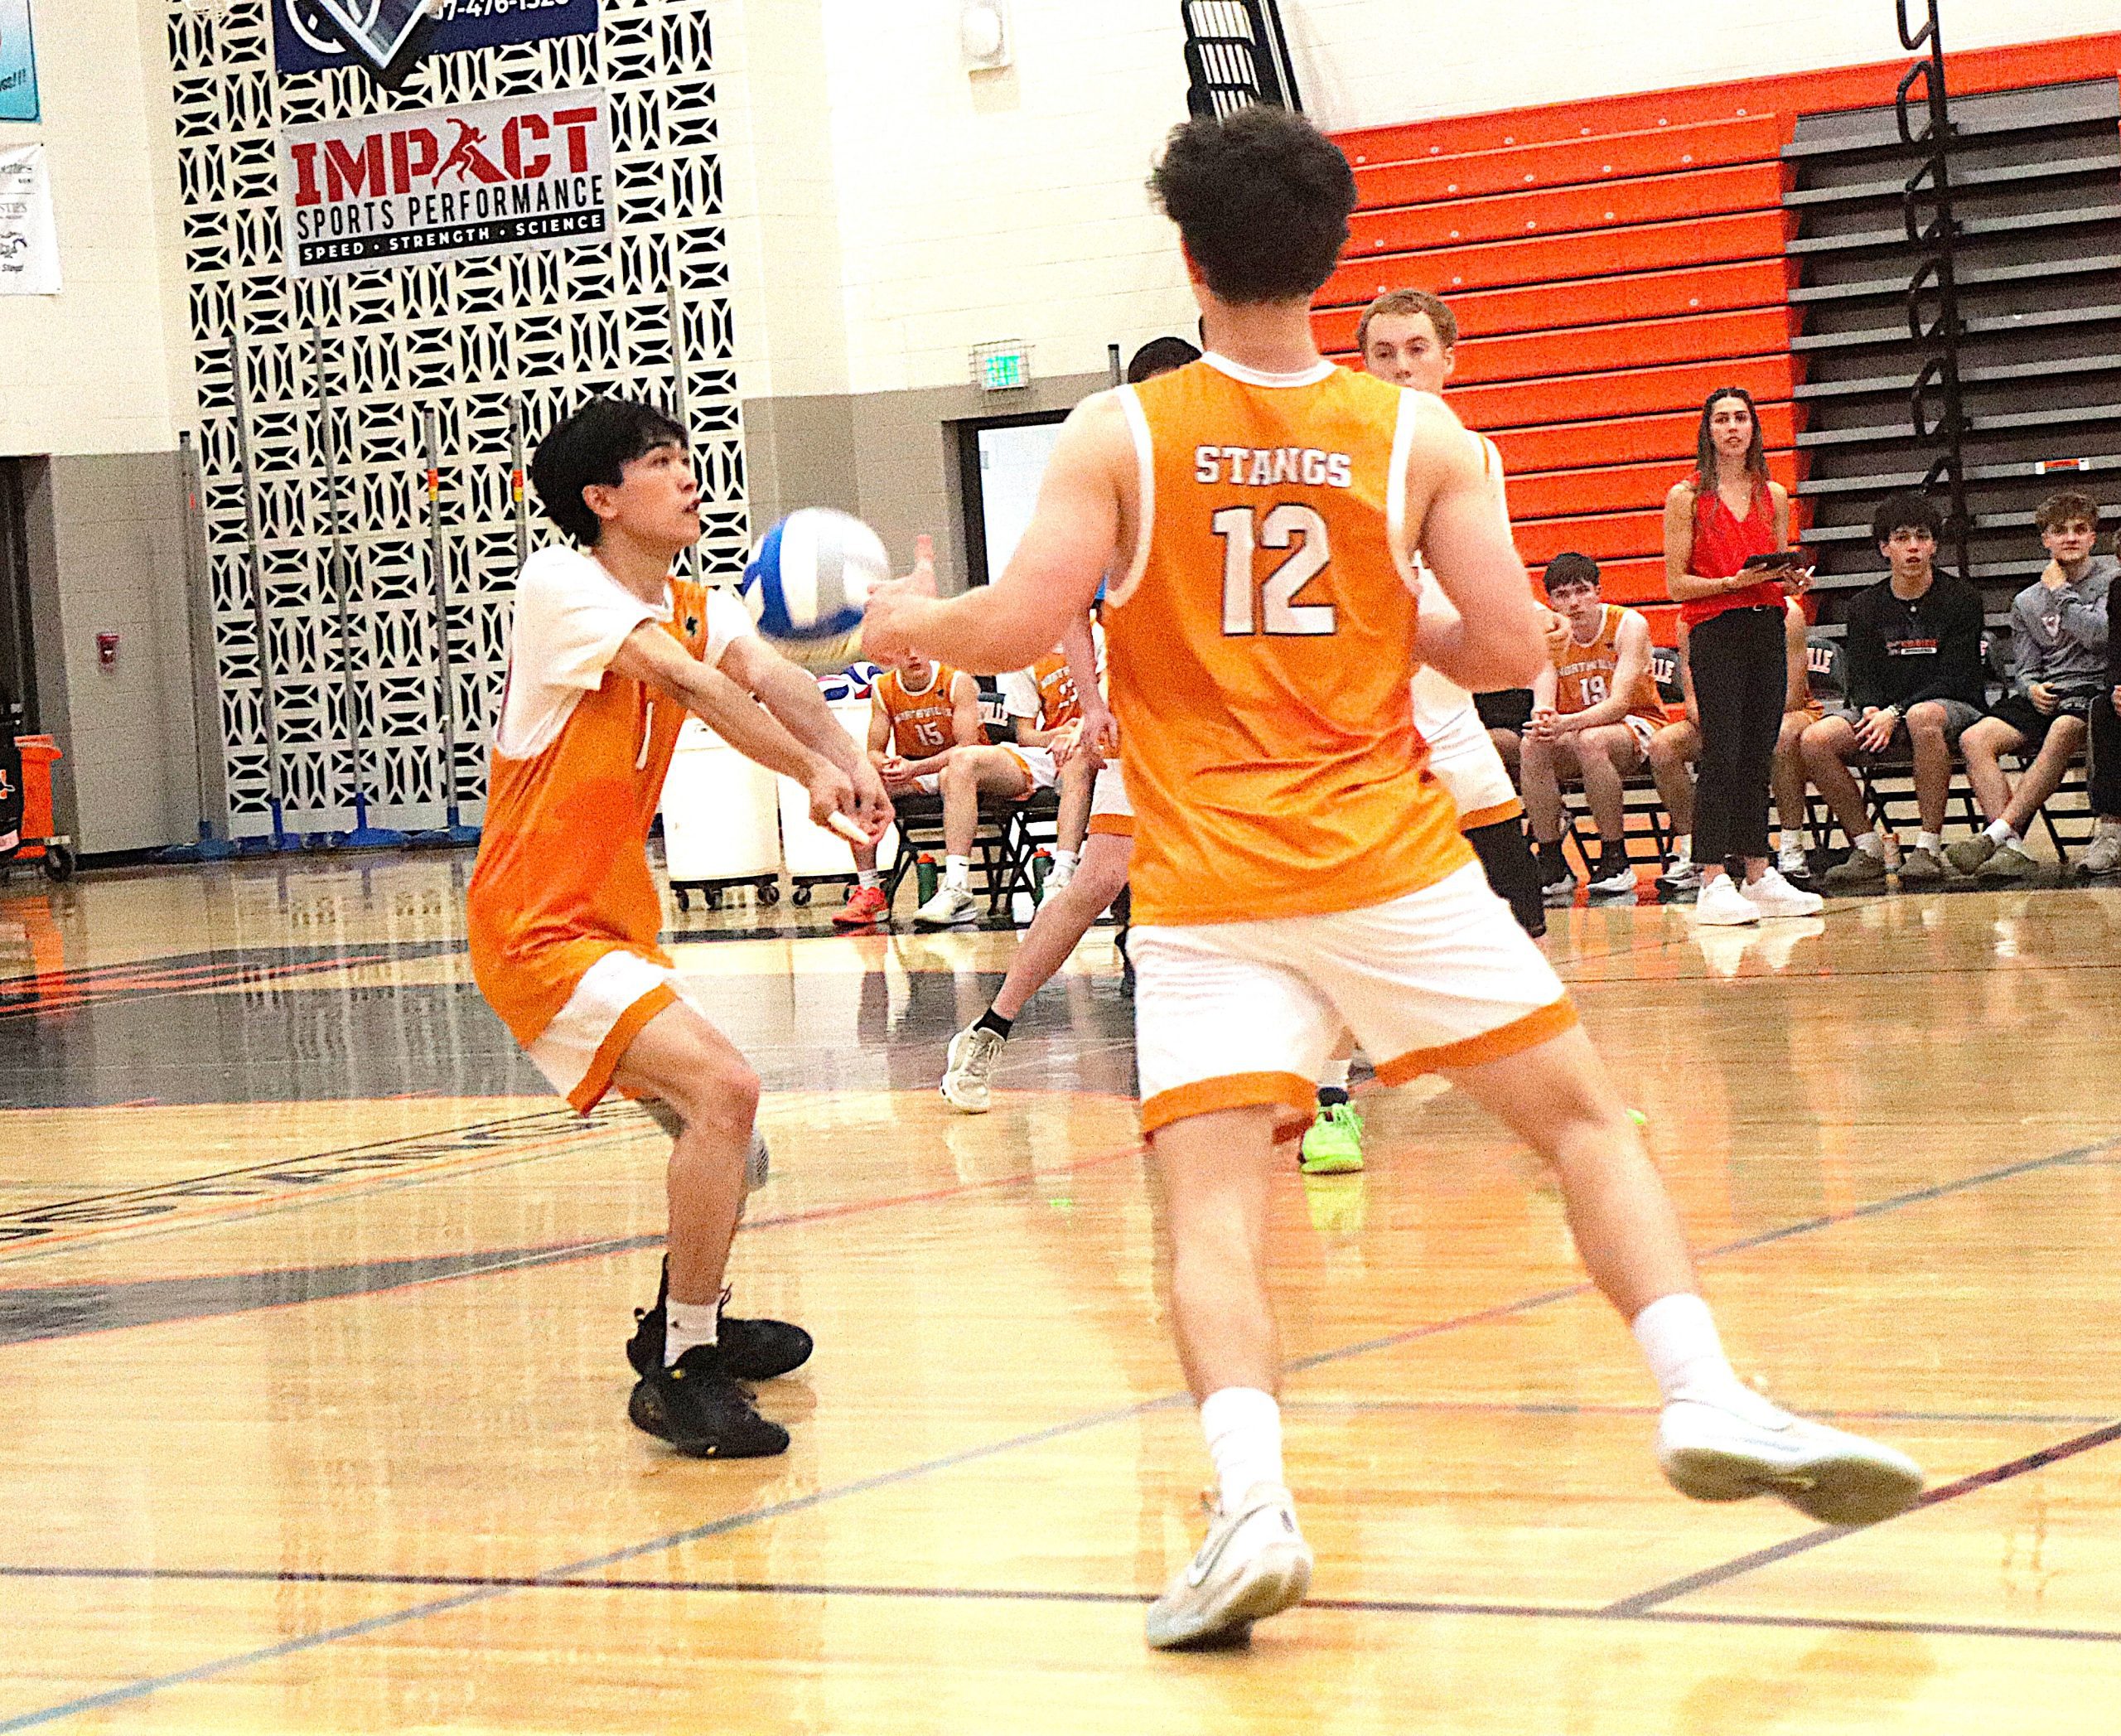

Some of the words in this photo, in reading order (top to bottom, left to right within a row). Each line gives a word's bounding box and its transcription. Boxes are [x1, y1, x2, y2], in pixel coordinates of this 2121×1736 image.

[291, 107, 597, 206] IMPACT
[297, 200, 394, 239] SPORTS
[408, 175, 604, 226] PERFORMANCE
[304, 242, 364, 260] SPEED
[389, 227, 490, 251] STRENGTH
[515, 214, 602, 236] SCIENCE
[1195, 445, 1352, 488] STANGS
[1212, 502, 1336, 636] 12
[1579, 675, 1608, 705] 19
[914, 721, 945, 746] 15
